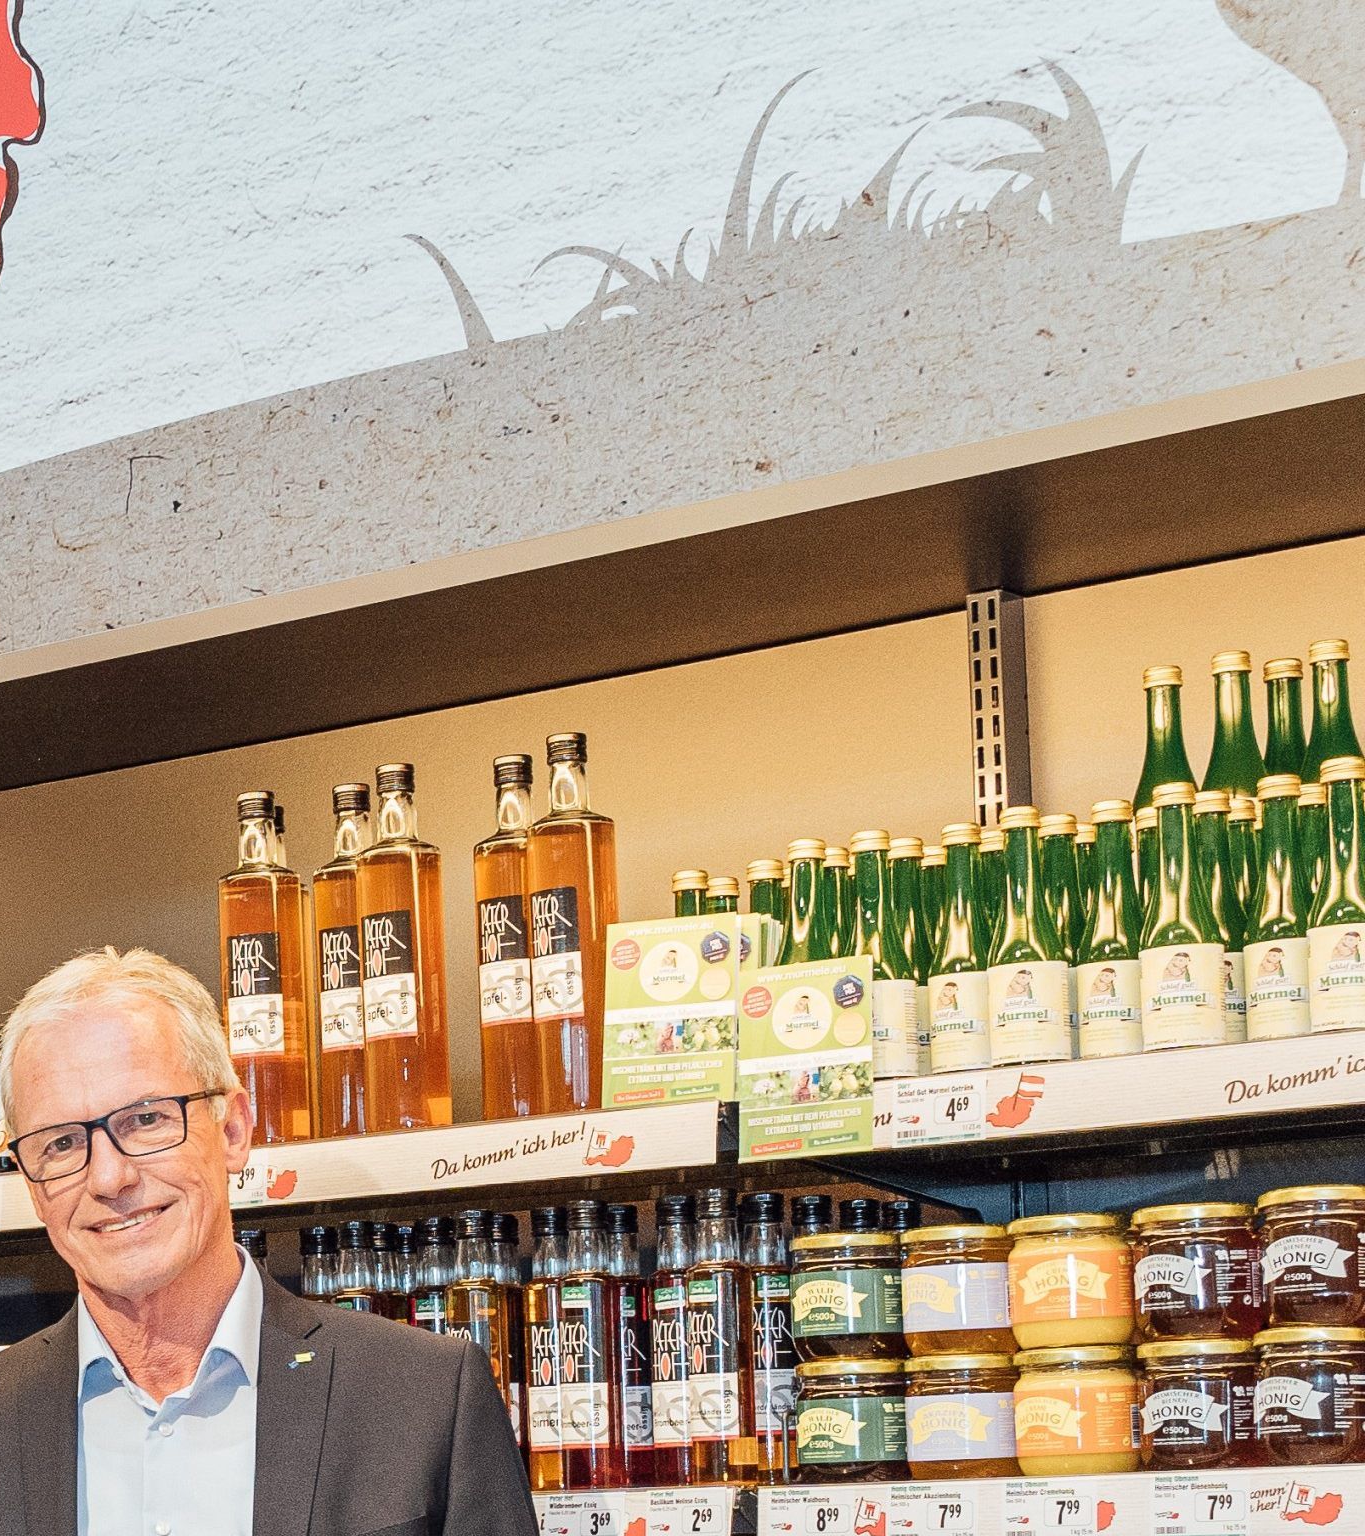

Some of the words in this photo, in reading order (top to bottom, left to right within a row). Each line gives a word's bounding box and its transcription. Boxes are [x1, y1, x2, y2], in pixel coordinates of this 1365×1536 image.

[481, 902, 522, 934] PETER
[532, 894, 572, 927] PETER
[365, 916, 407, 949] PETER
[533, 926, 567, 956] HOF
[232, 938, 275, 970] PETER
[323, 931, 360, 961] PETER
[481, 934, 516, 964] HOF
[365, 947, 401, 977] HOF
[231, 965, 270, 995] HOF
[322, 961, 358, 991] HOF
[483, 991, 507, 1008] apfel-
[535, 984, 559, 1001] apfel-
[1151, 992, 1207, 1006] Murmel
[1249, 987, 1302, 1003] Murmel
[368, 1005, 393, 1022] apfel-
[997, 1009, 1049, 1023] Murmel
[1082, 1007, 1132, 1020] Murmel
[233, 1020, 261, 1038] apfel-
[324, 1018, 349, 1034] apfel-
[785, 1020, 819, 1031] Murmel
[1224, 1079, 1262, 1104] Da
[1267, 1057, 1342, 1095] komm'
[431, 1158, 459, 1180] Da
[462, 1140, 518, 1175] komm'
[523, 1132, 548, 1153] ich
[550, 1121, 586, 1147] her!
[1272, 1251, 1327, 1268] HONIG
[1035, 1273, 1090, 1290] HONG
[1139, 1270, 1184, 1285] HONIG
[800, 1294, 845, 1309] HONIG
[560, 1321, 600, 1357] PETER
[560, 1354, 595, 1383] HOF
[653, 1352, 690, 1380] HOF
[1257, 1391, 1300, 1408] HONIG
[1020, 1411, 1061, 1425] HONIG
[1151, 1404, 1203, 1420] HONIG
[802, 1423, 843, 1436] HONIG
[921, 1417, 968, 1431] HONIG
